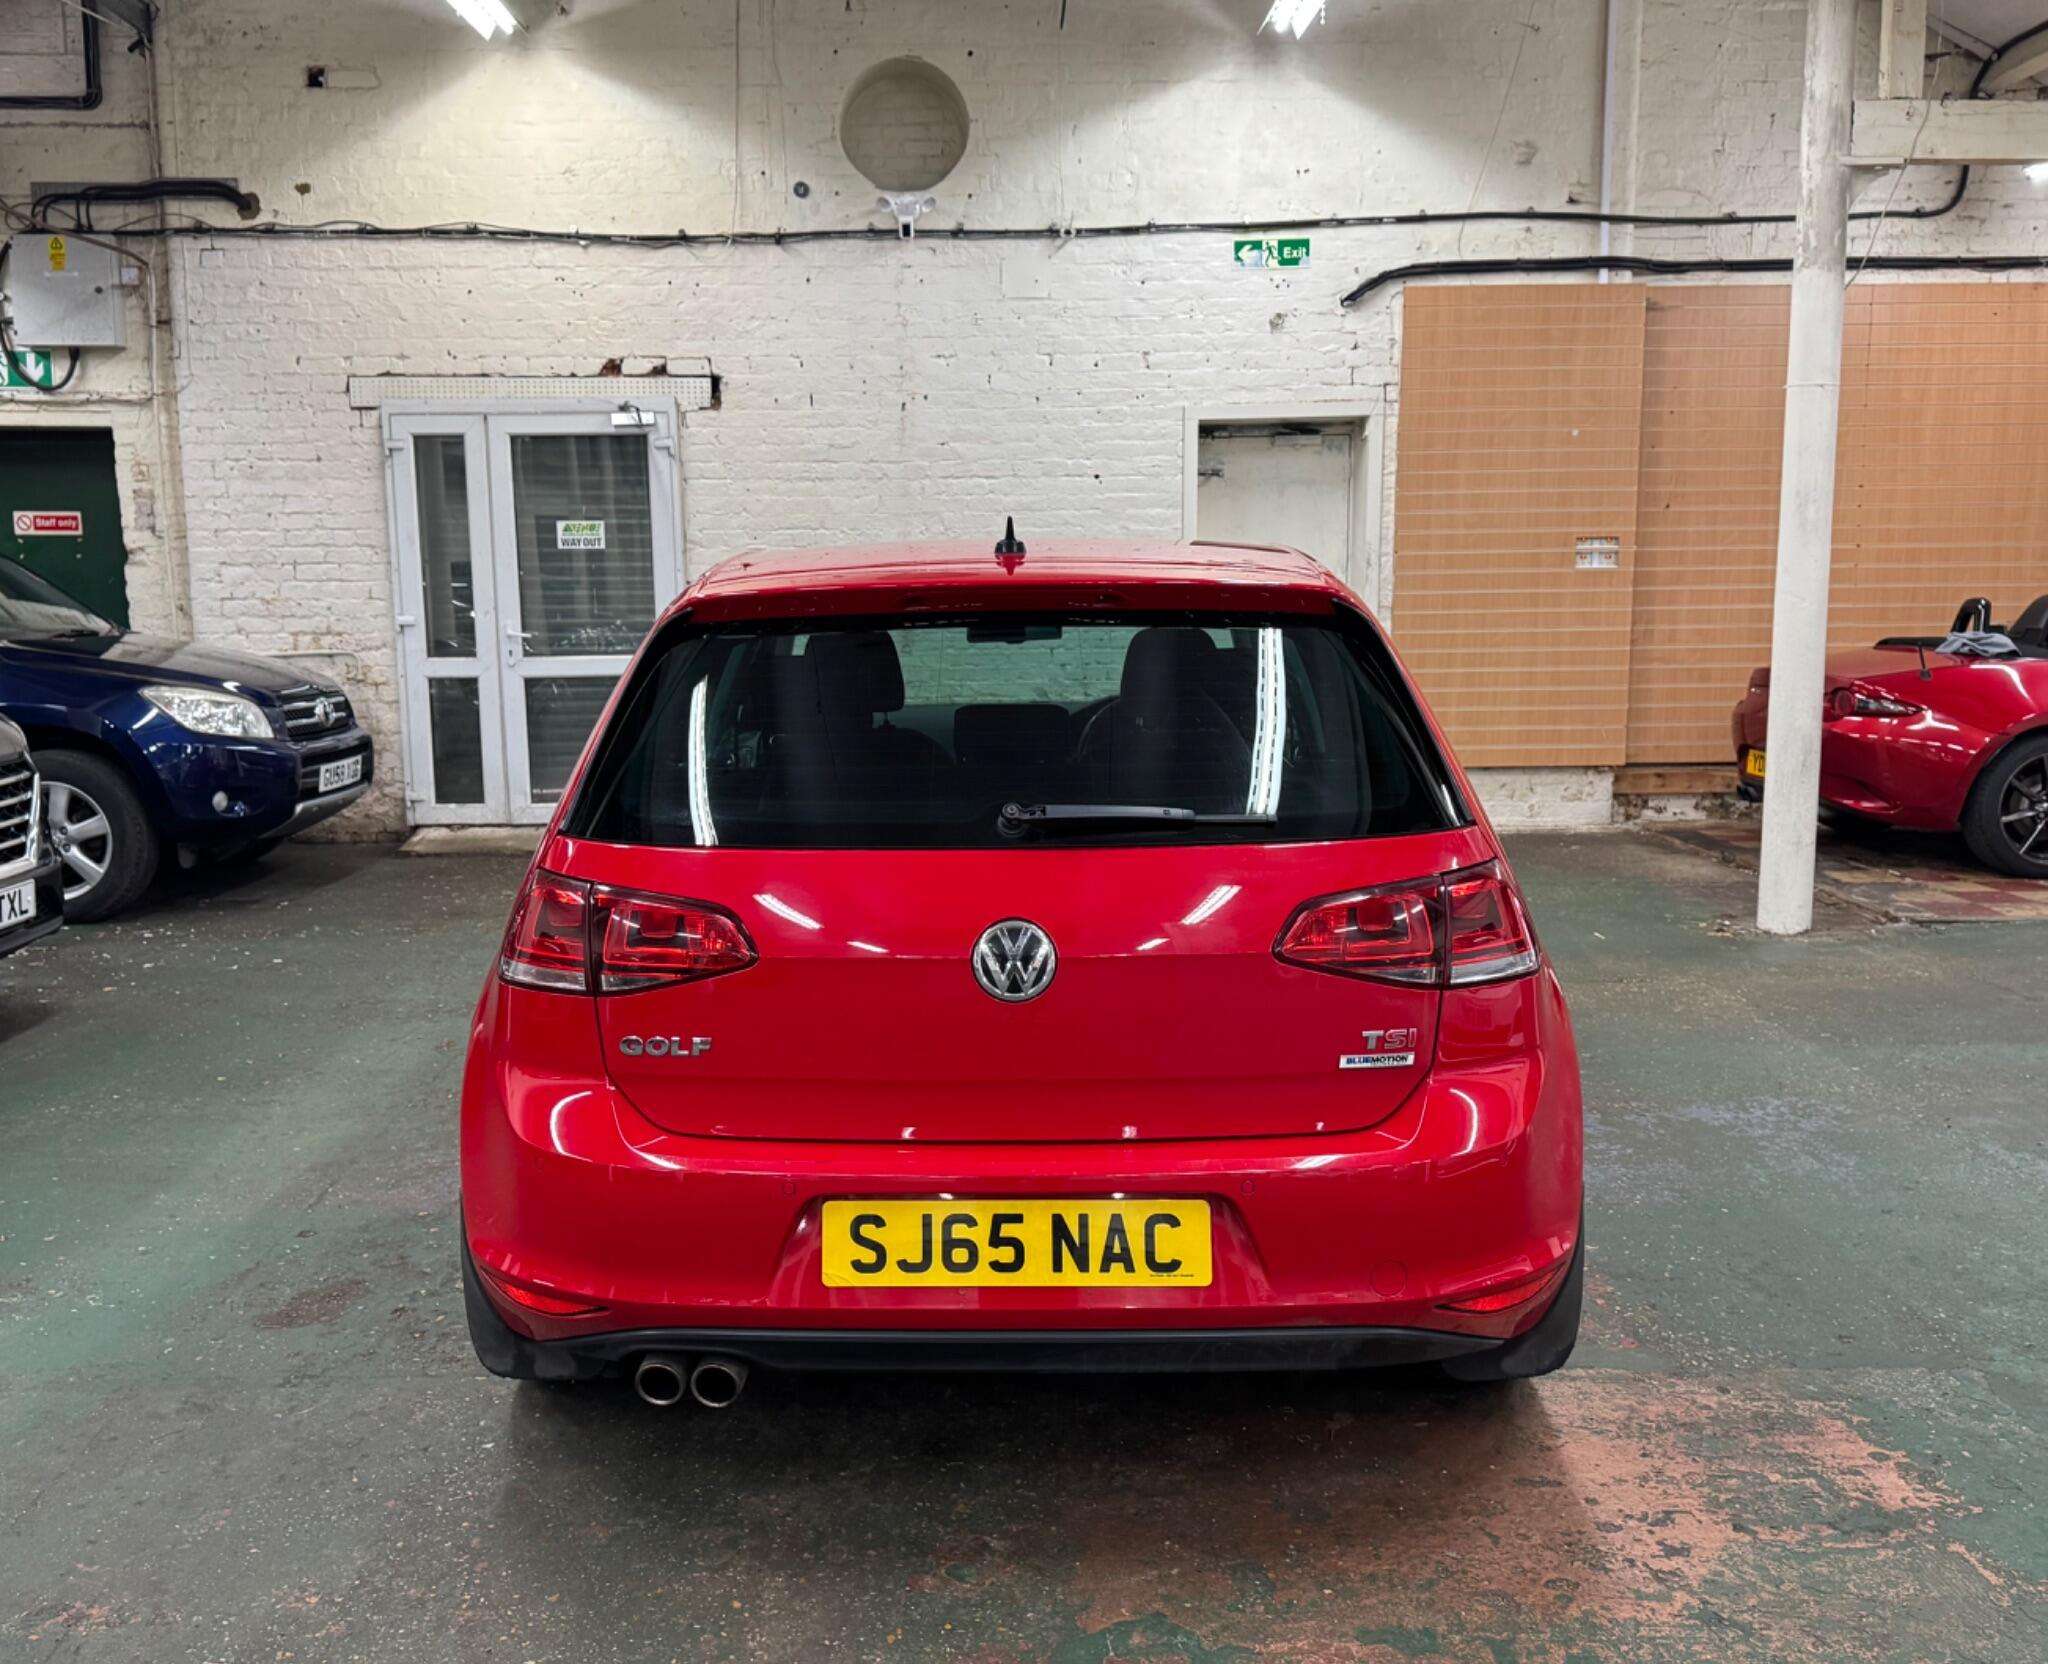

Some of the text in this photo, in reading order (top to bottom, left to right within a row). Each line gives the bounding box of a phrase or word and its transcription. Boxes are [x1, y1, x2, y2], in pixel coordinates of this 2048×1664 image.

[1283, 246, 1307, 259] Exit
[560, 537, 602, 547] WAY OUT
[620, 1035, 712, 1056] GOLF
[1362, 1028, 1417, 1050] TSI
[1346, 1055, 1409, 1065] BLUEMOTION
[849, 1212, 1183, 1274] SJ65 NAC
